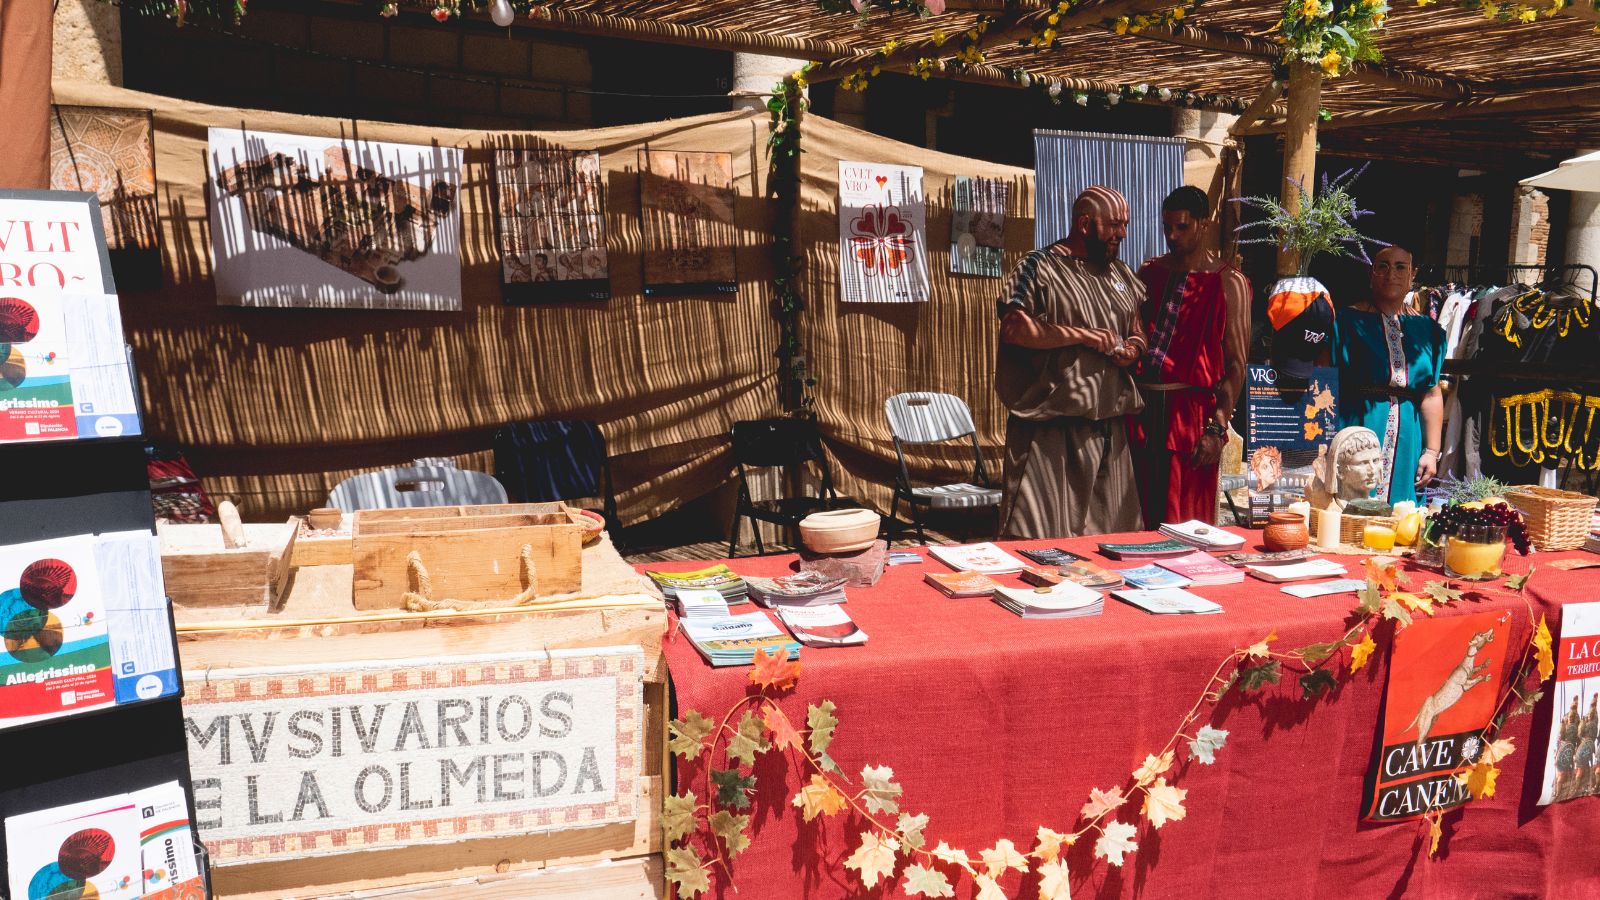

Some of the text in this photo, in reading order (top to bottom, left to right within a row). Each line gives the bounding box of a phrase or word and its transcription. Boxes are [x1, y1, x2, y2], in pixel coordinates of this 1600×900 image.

[844, 168, 872, 180] CVLT
[1304, 329, 1326, 344] VRO
[1249, 367, 1278, 385] VRO
[1568, 642, 1589, 660] LA
[6, 663, 96, 686] Allegrissimo
[184, 691, 573, 766] MVSIVARIOS
[1385, 739, 1454, 777] CAVE
[245, 770, 332, 826] LA
[354, 746, 607, 813] OLMEDA
